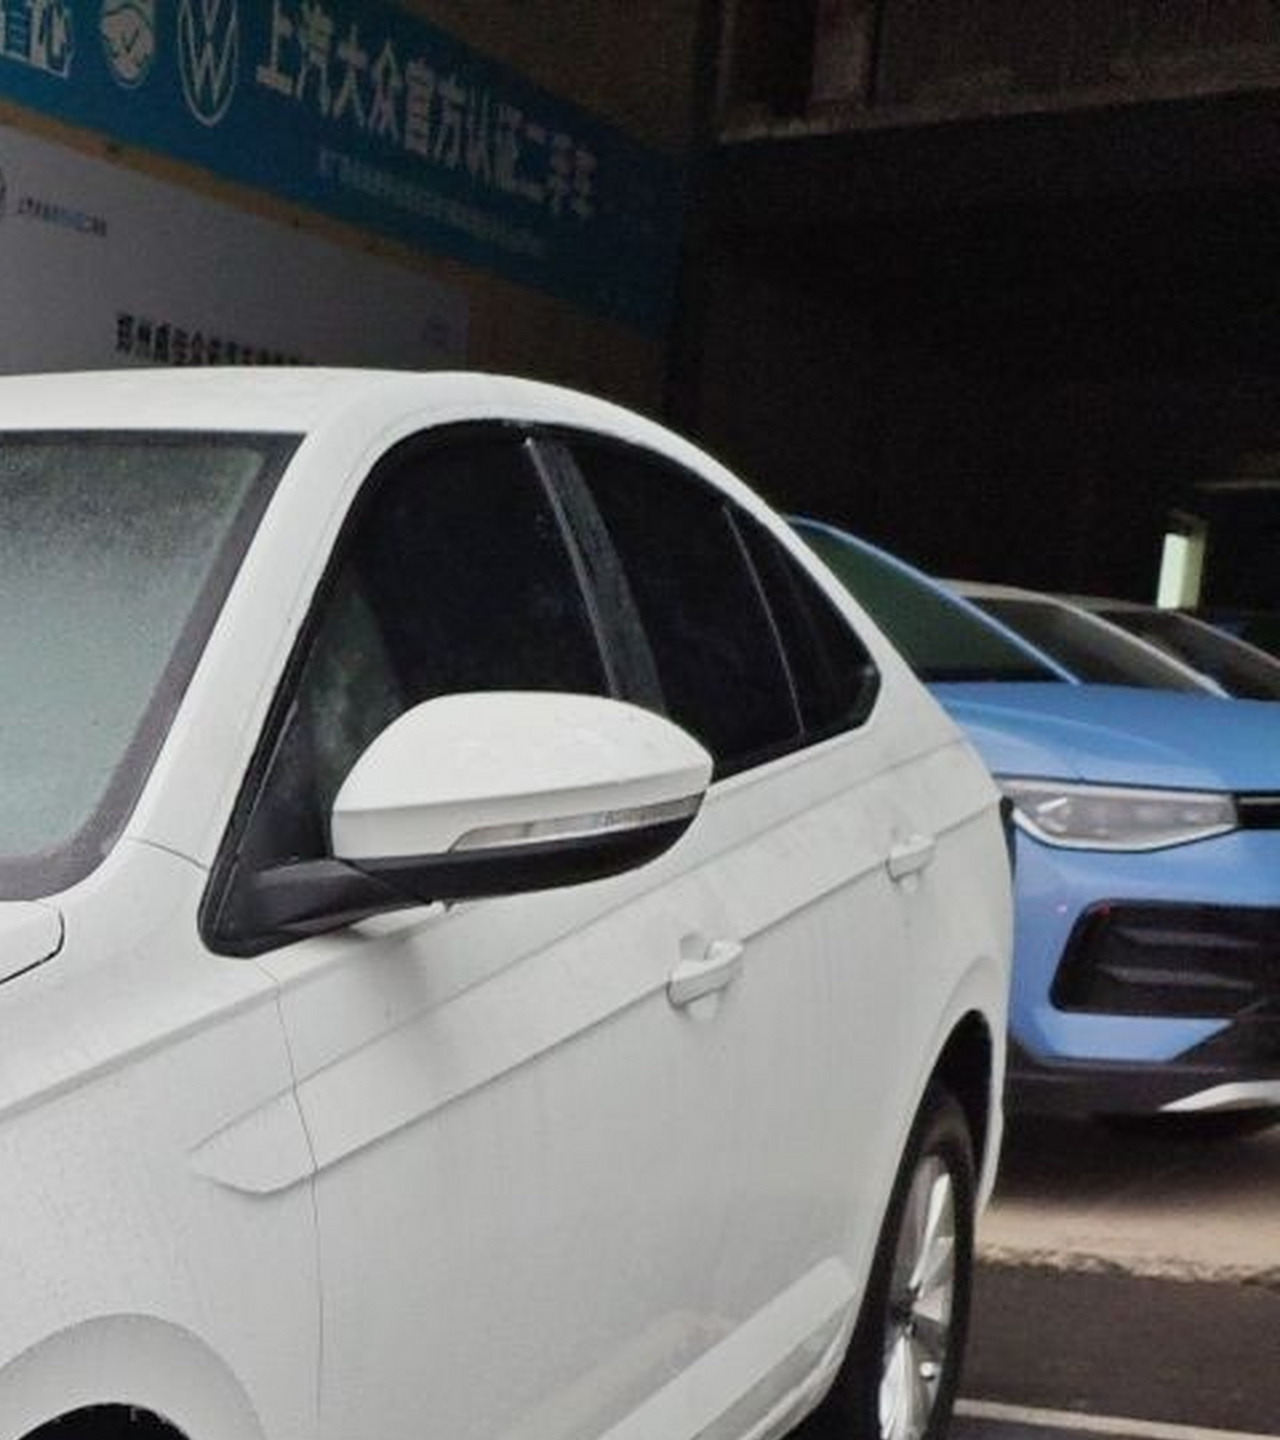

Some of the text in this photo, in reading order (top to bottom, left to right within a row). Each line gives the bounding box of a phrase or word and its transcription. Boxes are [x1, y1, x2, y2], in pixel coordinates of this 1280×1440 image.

[255, 0, 598, 217] 上汽大众官方认证二手车
